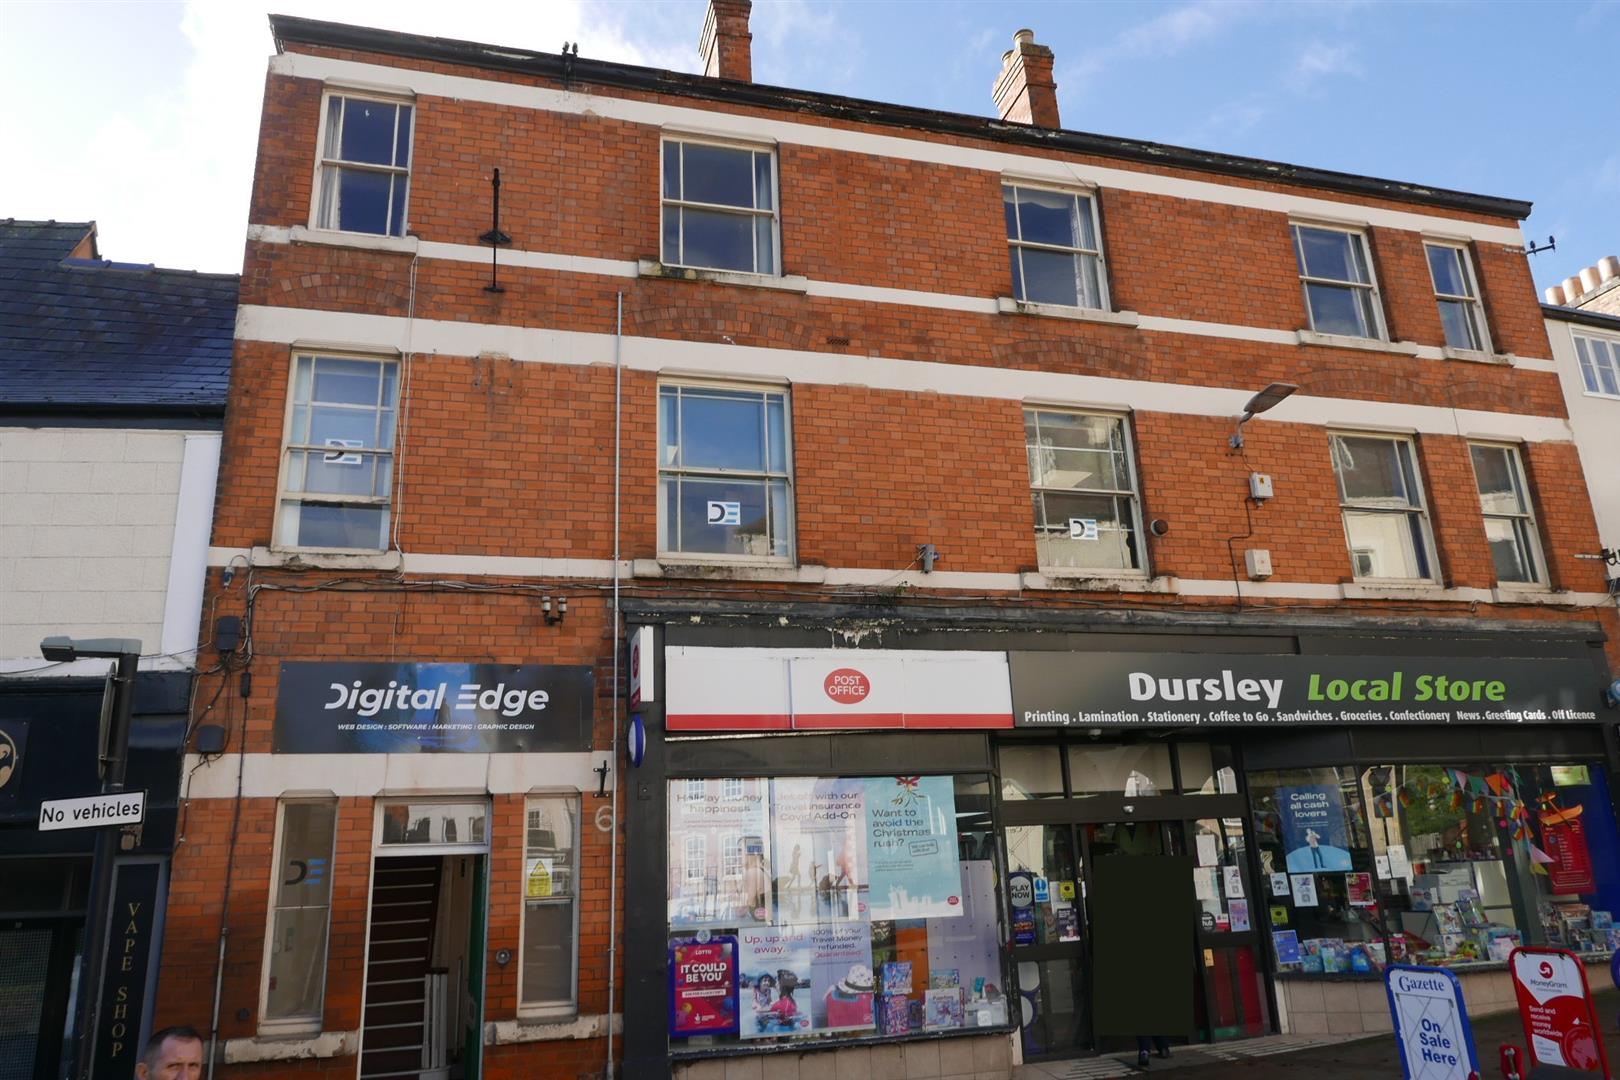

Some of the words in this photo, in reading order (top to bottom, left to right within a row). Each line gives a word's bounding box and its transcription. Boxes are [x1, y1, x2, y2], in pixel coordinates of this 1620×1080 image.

[834, 675, 861, 685] POST
[828, 685, 866, 696] OFFICE
[1128, 669, 1284, 709] Dursley
[1307, 671, 1403, 702] Local
[1414, 674, 1506, 702] Store
[324, 680, 447, 717] Digital
[455, 682, 549, 717] Edge
[1024, 711, 1070, 725] Printing
[1078, 711, 1139, 723] Lamination
[1147, 711, 1200, 725] Stationery
[1208, 710, 1241, 723] Coffee
[1242, 712, 1254, 723] to
[1255, 711, 1270, 723] Go
[1276, 709, 1333, 722] Sandwiches
[1340, 710, 1383, 722] Groceries
[1389, 709, 1451, 723] Confectionery
[1456, 709, 1481, 721] News
[1485, 709, 1523, 723] Greeting
[1522, 709, 1547, 721] Cards
[1551, 709, 1565, 720] Off
[1565, 709, 1596, 721] Licence
[338, 723, 355, 731] WEB
[356, 723, 385, 731] DESIGN
[387, 723, 428, 731] SOFTWARE
[431, 723, 473, 731] MARKETING
[477, 723, 508, 731] GRAPHIC
[508, 723, 535, 731] DESIGN
[815, 791, 839, 800] with
[840, 792, 859, 800] our
[1290, 792, 1326, 801] Calling
[1290, 801, 1302, 810] all
[1303, 800, 1330, 809] cash
[41, 807, 65, 823] No
[73, 801, 141, 820] vehicles
[814, 811, 856, 821] Add-On
[872, 808, 903, 818] Want
[904, 809, 917, 817] to
[1295, 809, 1328, 818] lovers
[872, 819, 903, 828] avoid
[905, 818, 924, 827] the
[872, 828, 931, 838] Christmas
[1010, 884, 1030, 892] PLAY
[121, 902, 141, 972] VAPE
[765, 935, 779, 944] up
[811, 935, 835, 944] Travel
[680, 964, 690, 974] IT
[691, 962, 727, 974] COULD
[685, 974, 699, 983] BE
[700, 972, 722, 982] YOU
[1398, 975, 1445, 992] Gazette
[111, 986, 129, 1058] SHOP
[1421, 1018, 1441, 1033] On
[1419, 1032, 1451, 1049] Sale
[1421, 1047, 1457, 1066] Here
